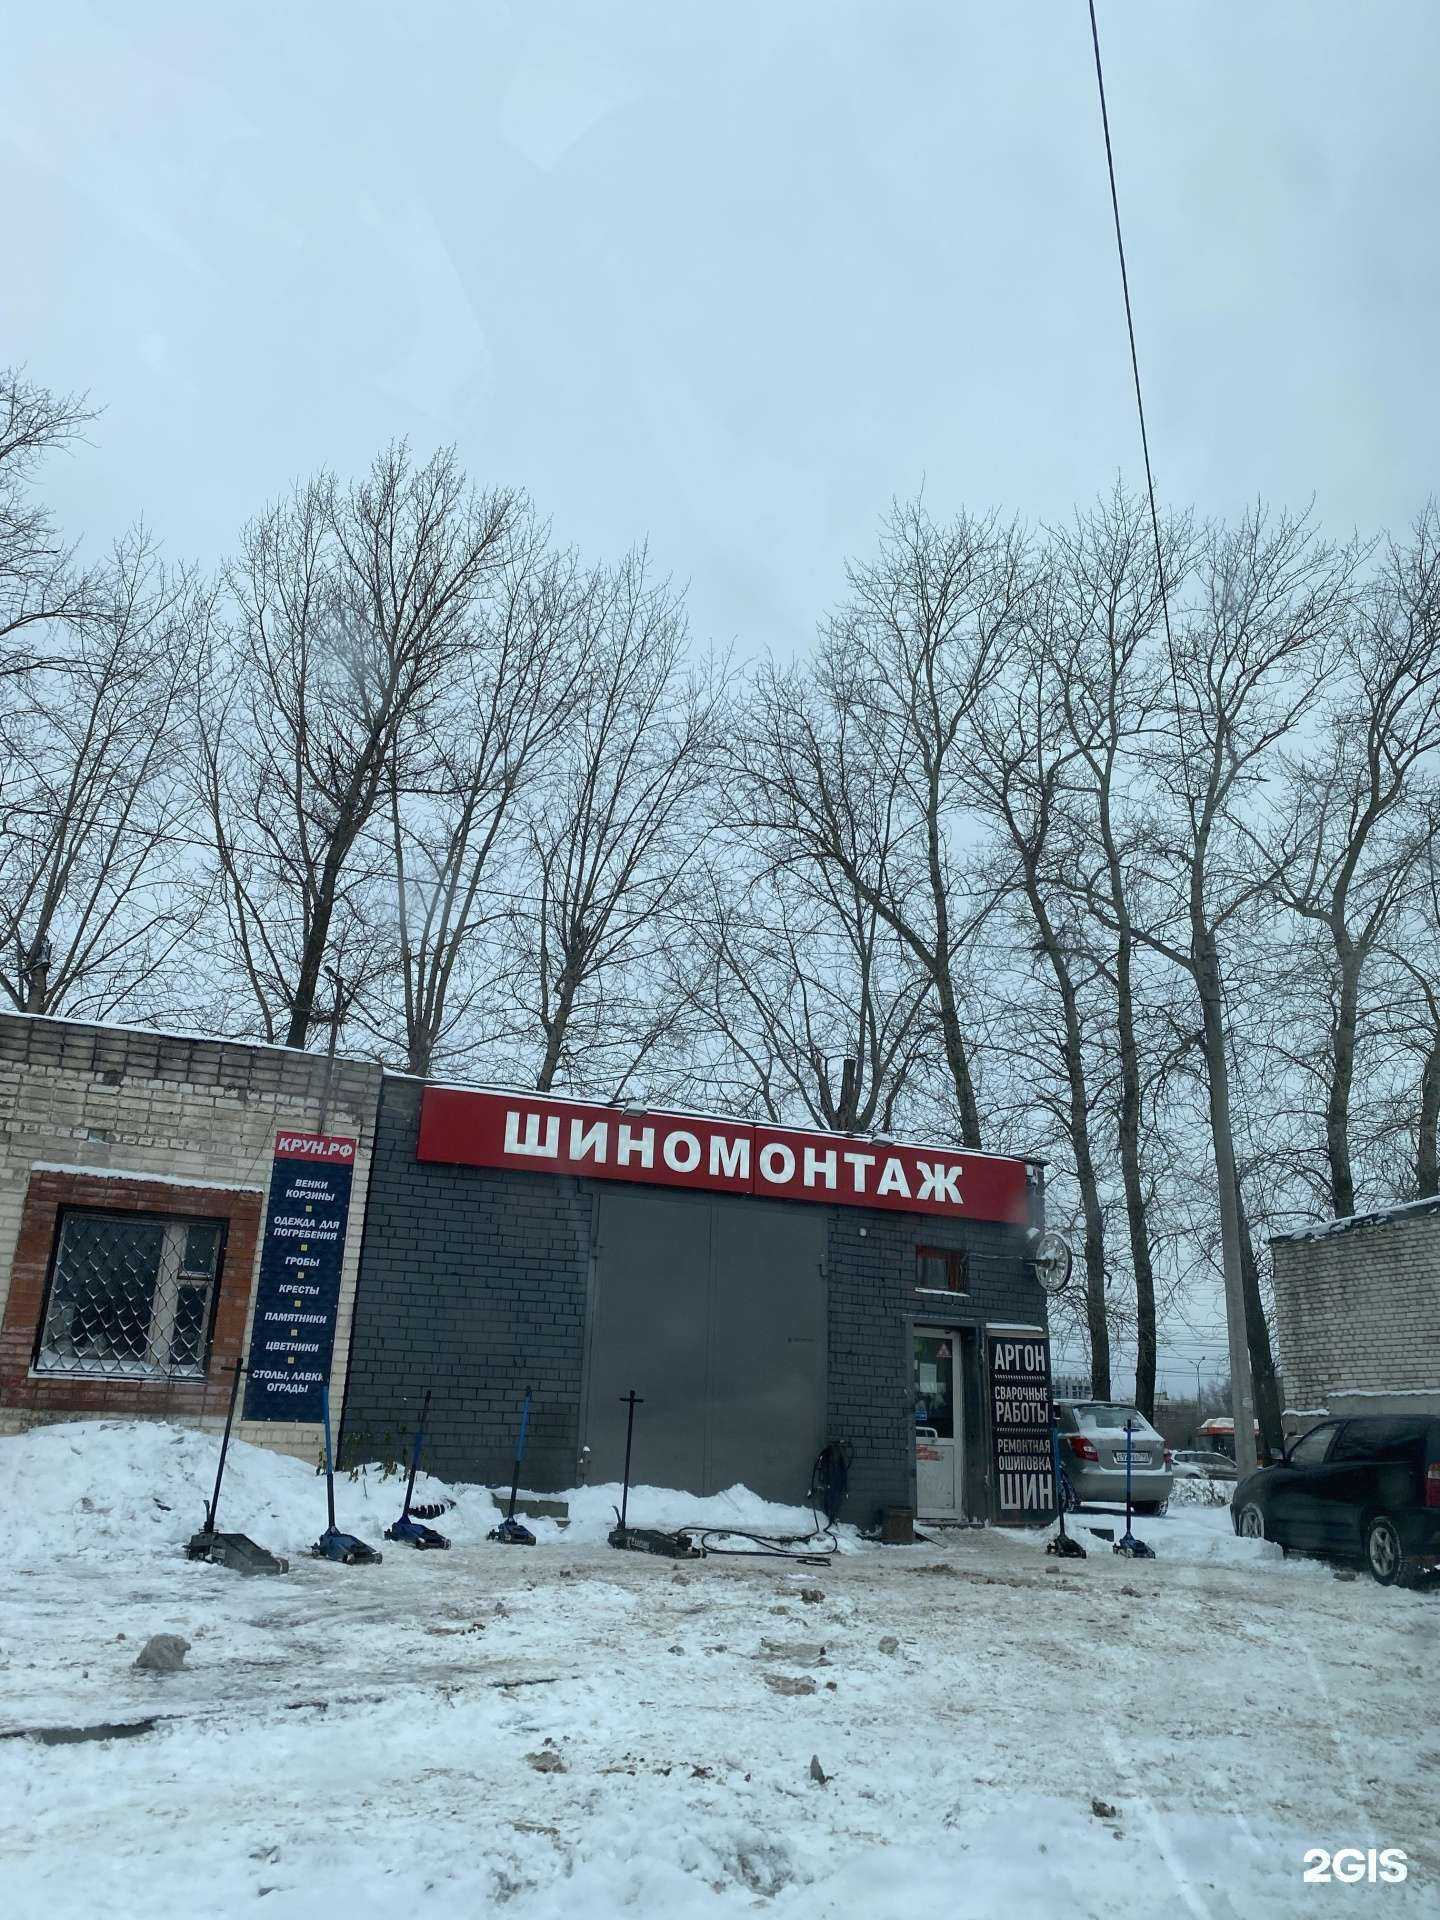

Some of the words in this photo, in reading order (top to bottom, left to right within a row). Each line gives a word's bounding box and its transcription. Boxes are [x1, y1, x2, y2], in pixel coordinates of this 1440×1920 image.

[278, 1137, 353, 1158] КРУН.РФ
[503, 1111, 964, 1205] ШИНОМОНТАЖ
[294, 1178, 329, 1190] ВЕНКИ
[285, 1189, 336, 1202] КОРЗИНЫ
[273, 1215, 316, 1228] ОДЕЖДА
[319, 1219, 340, 1230] ДЛЯ
[273, 1227, 338, 1241] ПОГРЕБЕНИЯ
[284, 1256, 321, 1267] ГРОБЫ
[278, 1284, 320, 1295] КРЕСТЫ
[264, 1311, 328, 1324] ПАМЯТНИКИ
[265, 1341, 320, 1353] ЦВЕТНИКИ
[994, 1343, 1046, 1372] АРГОН
[252, 1369, 290, 1382] СТОЛЫ,
[266, 1382, 309, 1394] ОГРАДЫ
[994, 1385, 1048, 1401] СВАРОЧНЫЕ
[995, 1401, 1049, 1423] РАБОТЫ
[997, 1438, 1051, 1454] РЕМОНТНАЯ
[998, 1455, 1052, 1471] ОШИПОВКА
[999, 1473, 1054, 1510] ШИН
